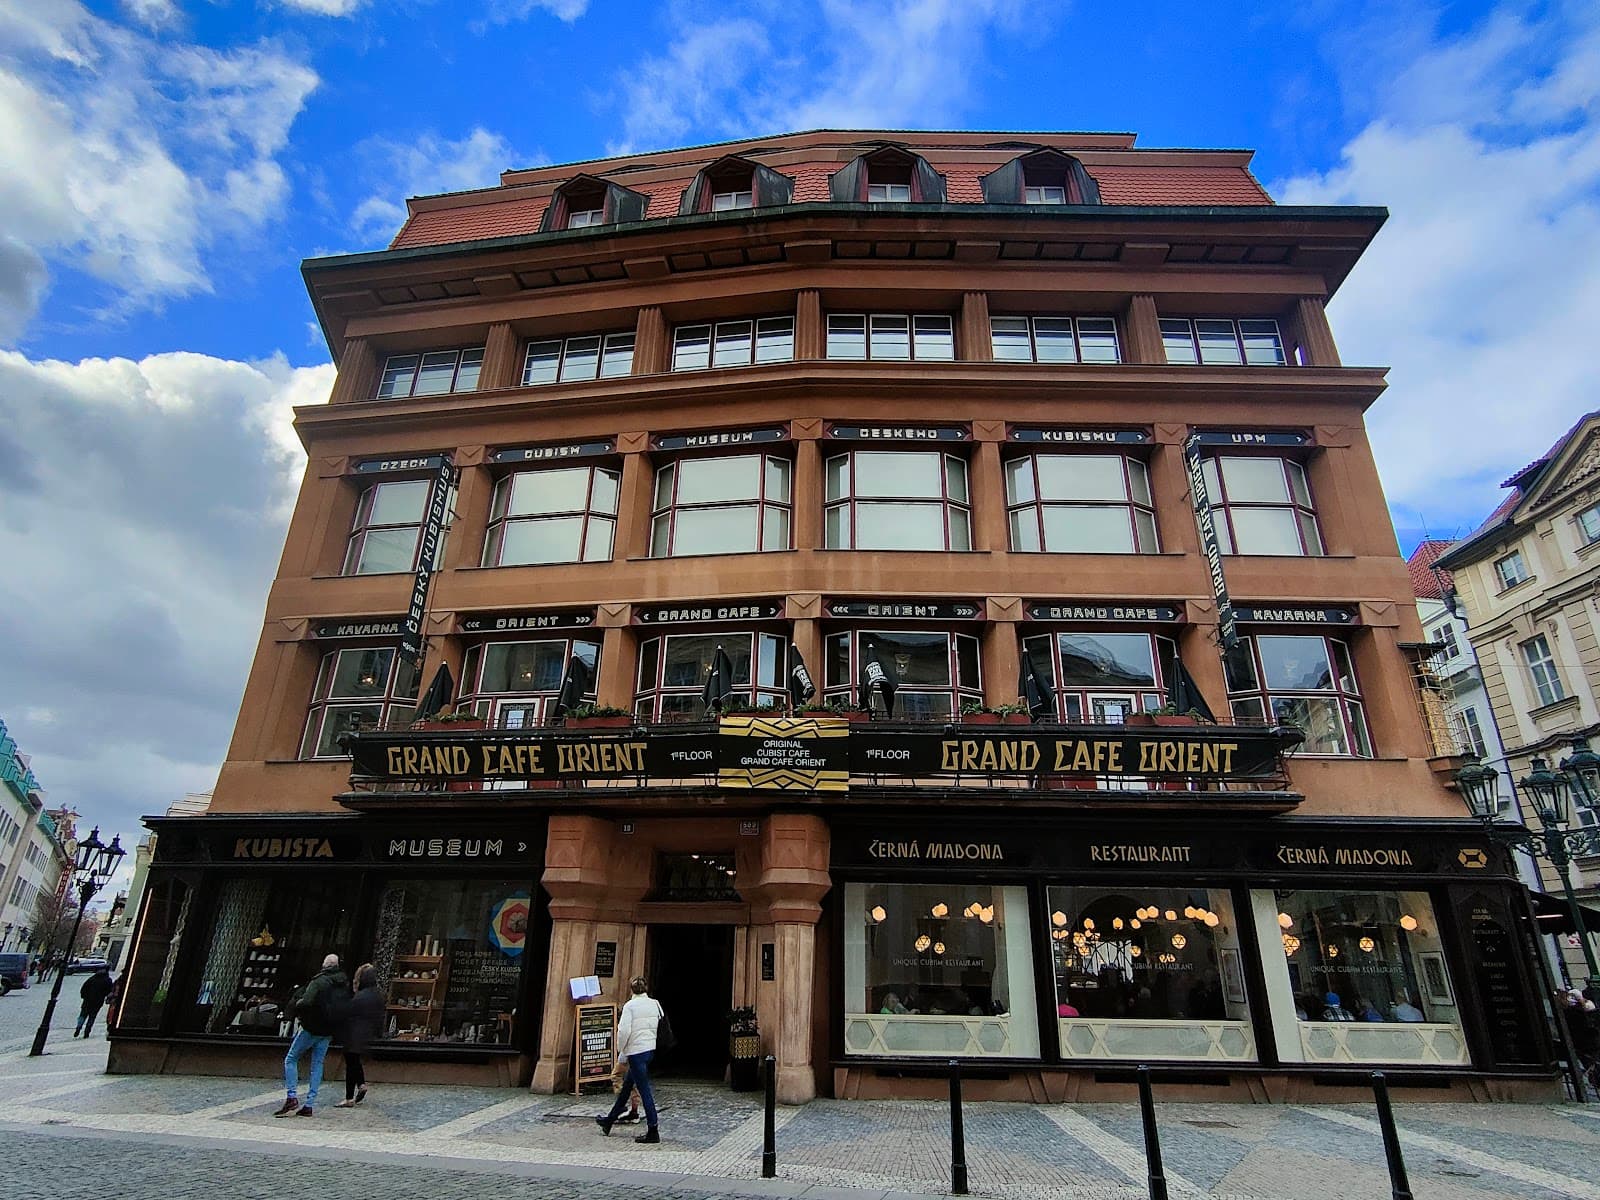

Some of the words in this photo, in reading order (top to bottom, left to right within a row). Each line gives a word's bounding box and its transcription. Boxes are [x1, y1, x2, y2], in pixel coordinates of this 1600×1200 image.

[686, 432, 753, 446] MUSEUM
[1042, 431, 1116, 442] KUBISMU
[1232, 434, 1266, 443] UPM
[524, 446, 580, 459] CUBISM
[380, 458, 428, 470] CZECH
[1189, 452, 1206, 504] ORIENT
[423, 465, 450, 562] KUBISMUS
[1199, 504, 1215, 542] CAFE
[1207, 545, 1225, 596] GRAND
[658, 608, 712, 621] GRAND
[718, 606, 760, 618] CAFE
[868, 606, 938, 616] ORIENT
[1050, 607, 1107, 618] GRAND
[1114, 608, 1158, 619] CAFE
[496, 616, 558, 628] ORIENT
[763, 740, 804, 748] ORIGINAL
[387, 746, 470, 775] GRAND
[482, 745, 545, 774] CAFE
[556, 742, 647, 773] ORIENT
[756, 748, 787, 757] CUBIST
[788, 750, 811, 758] CAFE
[941, 740, 1040, 771] GRAND
[1054, 740, 1123, 772] CAFE
[1138, 741, 1238, 773] ORIENT
[740, 756, 770, 765] GRAND
[772, 758, 794, 766] CAFE
[794, 758, 826, 766] ORIENT
[233, 838, 335, 858] KUBISTA
[388, 839, 503, 856] MUSEUM
[868, 839, 920, 858] ČERNÁ
[926, 842, 1004, 860] MADONA
[1090, 846, 1191, 862] RESTAURANT
[1276, 845, 1330, 864] ČERNÁ
[1335, 848, 1413, 866] MADONA
